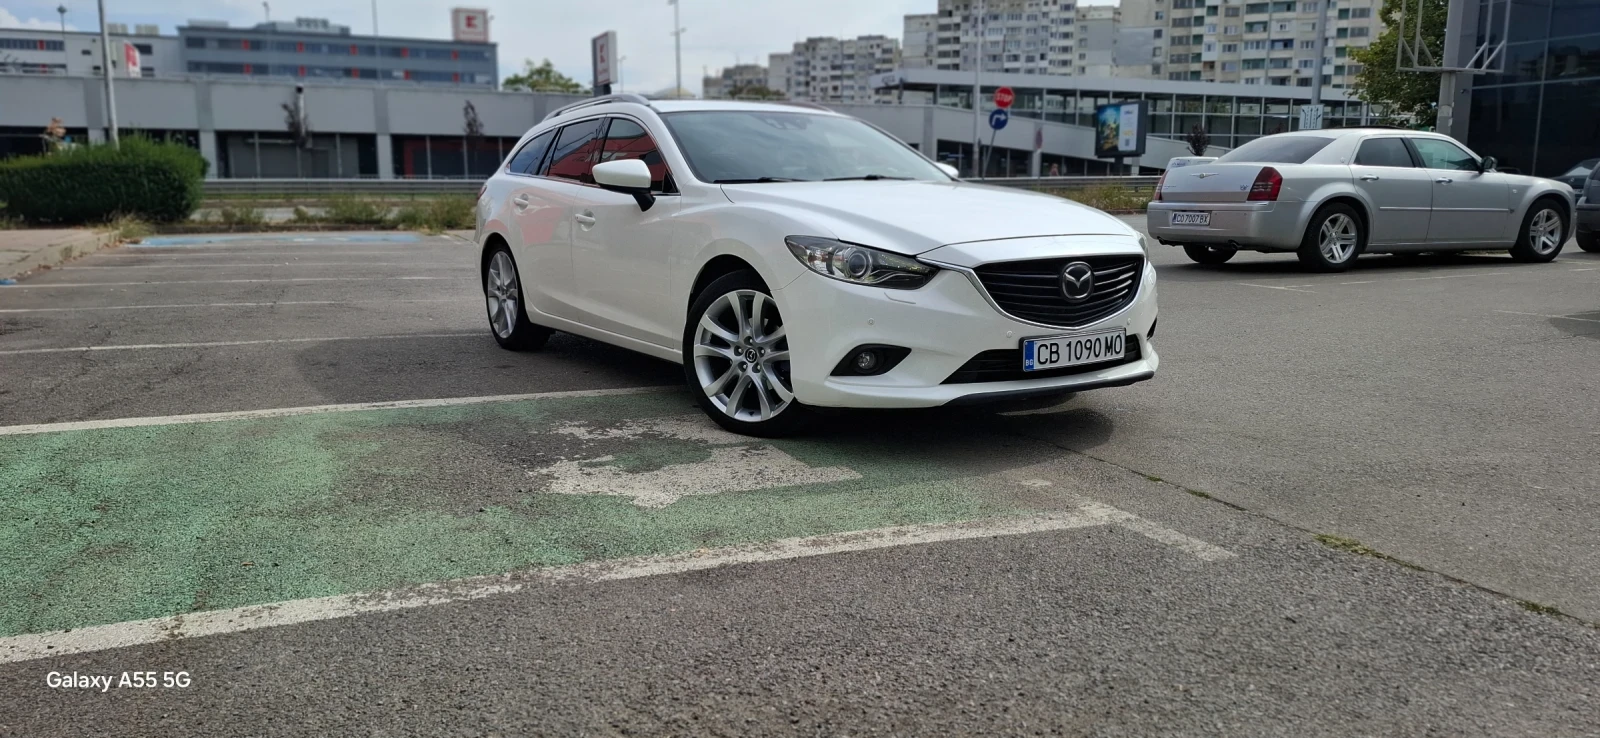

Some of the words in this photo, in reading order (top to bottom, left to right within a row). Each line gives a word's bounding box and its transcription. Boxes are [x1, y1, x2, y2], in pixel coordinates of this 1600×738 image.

[995, 92, 1013, 102] STOP
[1037, 342, 1060, 365] CB
[1066, 338, 1101, 362] 1090
[1104, 335, 1123, 357] MO
[1025, 359, 1034, 367] BG
